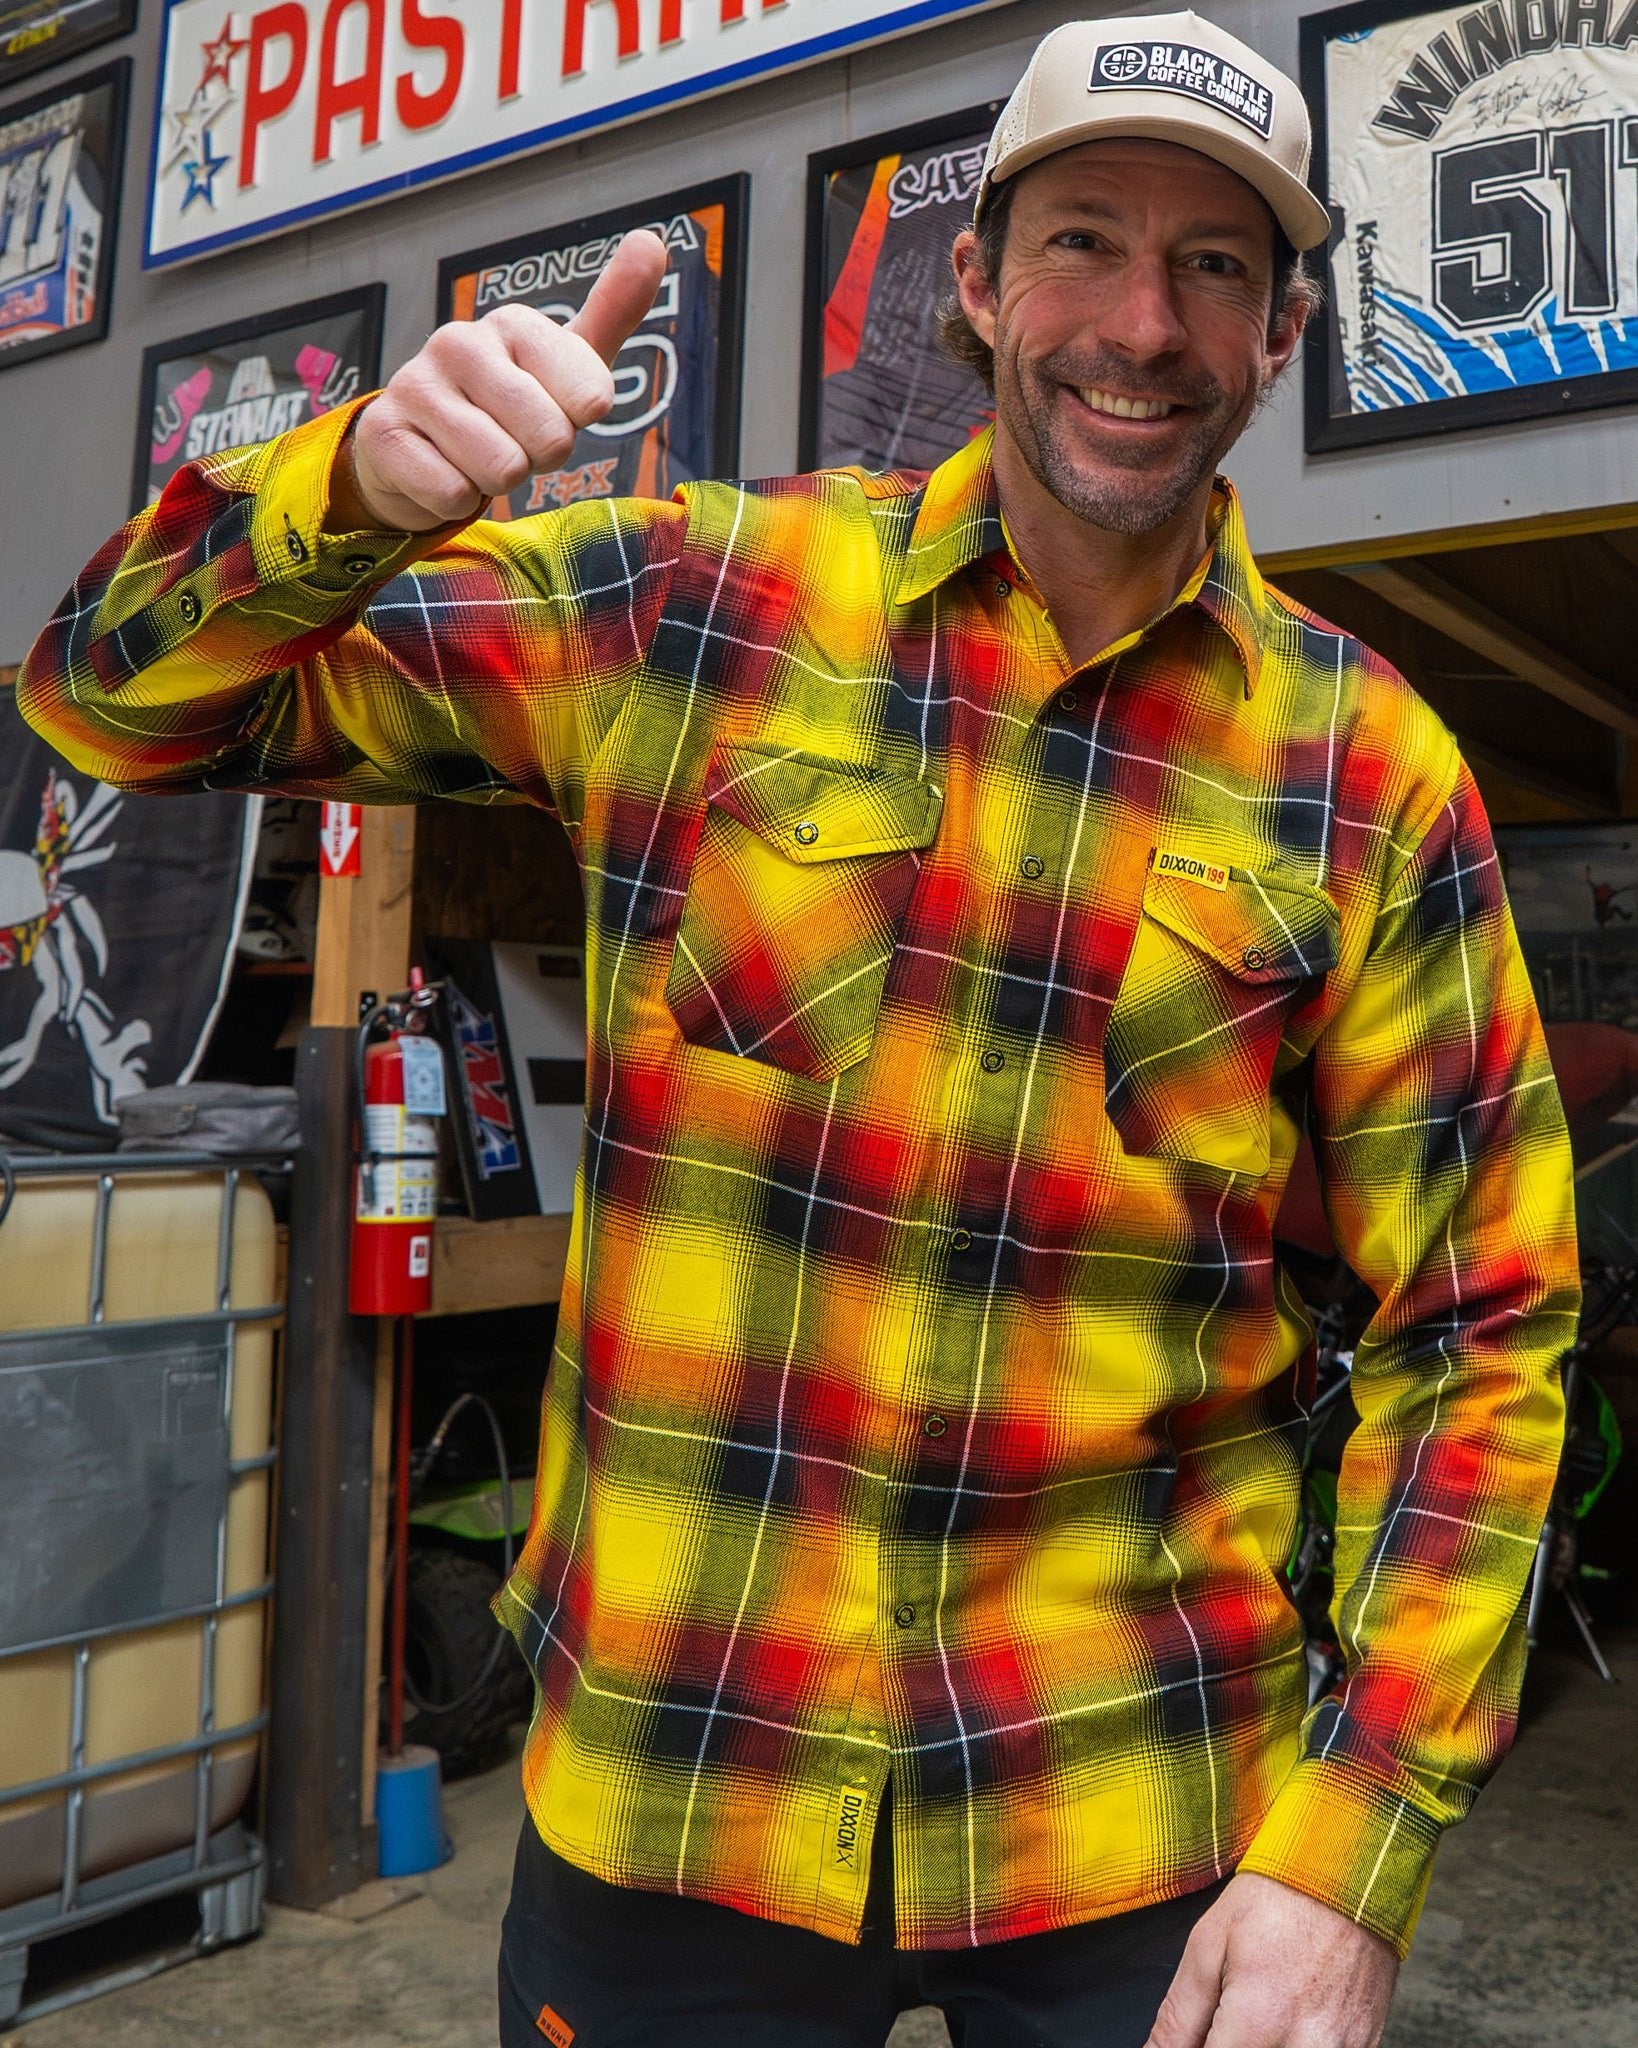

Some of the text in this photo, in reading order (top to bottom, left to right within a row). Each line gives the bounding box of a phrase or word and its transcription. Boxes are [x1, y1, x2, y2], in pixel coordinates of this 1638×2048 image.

[238, 0, 788, 190] PAST
[1147, 66, 1268, 126] COFFEE COMPANY
[1150, 46, 1268, 110] BLACK RIFLE
[1372, 0, 1638, 142] WINDH
[476, 213, 700, 306] RONCA
[1431, 115, 1638, 332] 51
[1355, 219, 1385, 369] Kawasaki
[184, 389, 310, 460] STEWART
[1159, 854, 1225, 885] DIXXON 199
[836, 1794, 862, 1851] DIXXON
